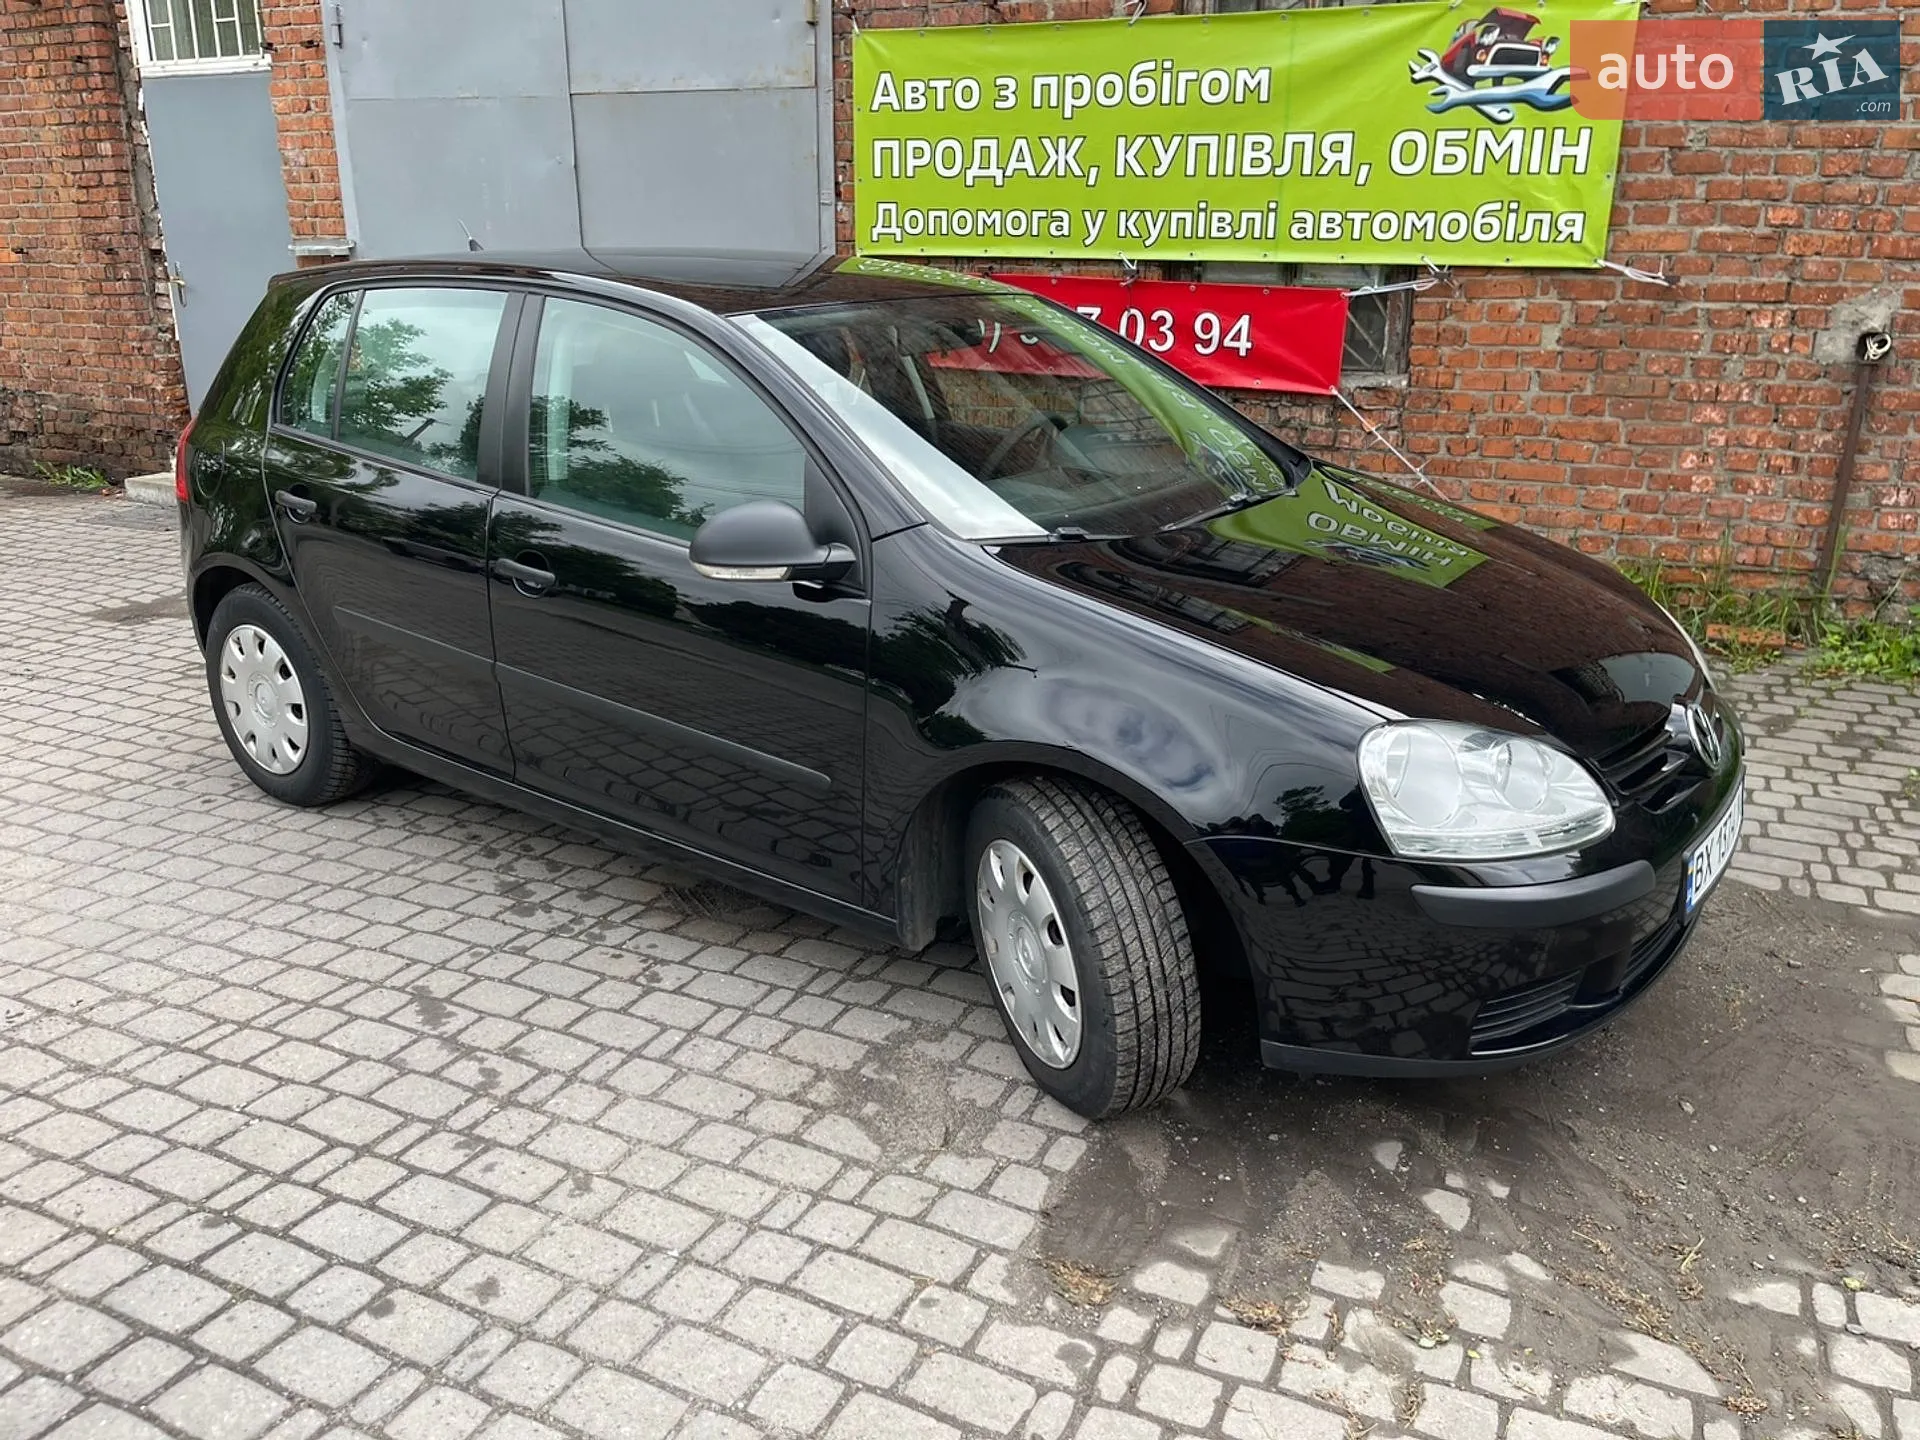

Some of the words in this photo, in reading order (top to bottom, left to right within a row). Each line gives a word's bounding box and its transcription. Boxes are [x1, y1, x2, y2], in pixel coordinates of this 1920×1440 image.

[870, 70, 981, 113] Авто
[993, 77, 1018, 111] з
[1031, 60, 1272, 118] пробігом
[870, 135, 1100, 188] ПРОДАЖ,
[1115, 130, 1372, 187] КУПІВЛЯ,
[1388, 127, 1593, 177] ОБМІН
[871, 202, 1072, 244] Допомога
[1081, 210, 1109, 246] у
[1116, 201, 1278, 248] купівлі
[1290, 201, 1587, 244] автомобіля
[1118, 307, 1175, 352] 03
[1193, 311, 1253, 357] 94
